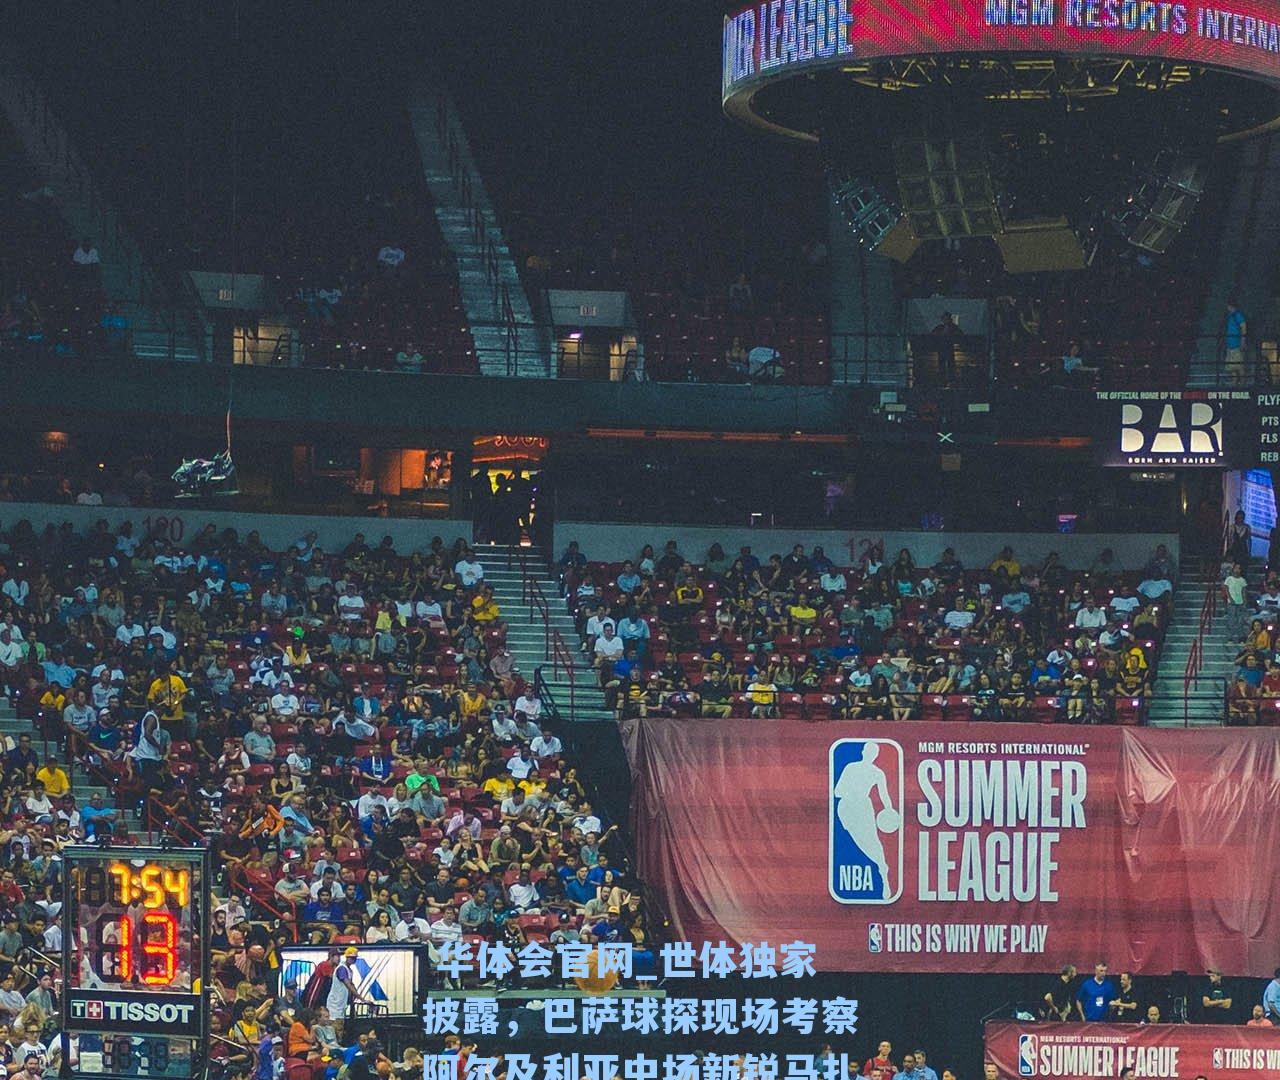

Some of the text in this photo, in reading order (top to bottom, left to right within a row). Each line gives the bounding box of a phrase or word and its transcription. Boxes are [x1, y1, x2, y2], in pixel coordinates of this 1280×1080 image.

[1065, 0, 1187, 34] RESORTS
[1261, 416, 1279, 427] PTS
[1261, 433, 1278, 444] FLS
[1260, 452, 1279, 462] REB
[918, 742, 1087, 755] MGM RESORTS INTERNATIONAL
[917, 759, 1087, 828] SUMMER
[839, 865, 874, 892] NBA
[918, 831, 1060, 902] LEAGUE
[109, 862, 190, 908] 7:54
[120, 912, 178, 986] 13
[885, 923, 1048, 953] THIS IS WHY WE PLAY
[105, 1003, 194, 1024] TISSOT
[1039, 1045, 1114, 1078] SUMMER
[1224, 1048, 1251, 1069] THIS
[1252, 1049, 1264, 1069] IS
